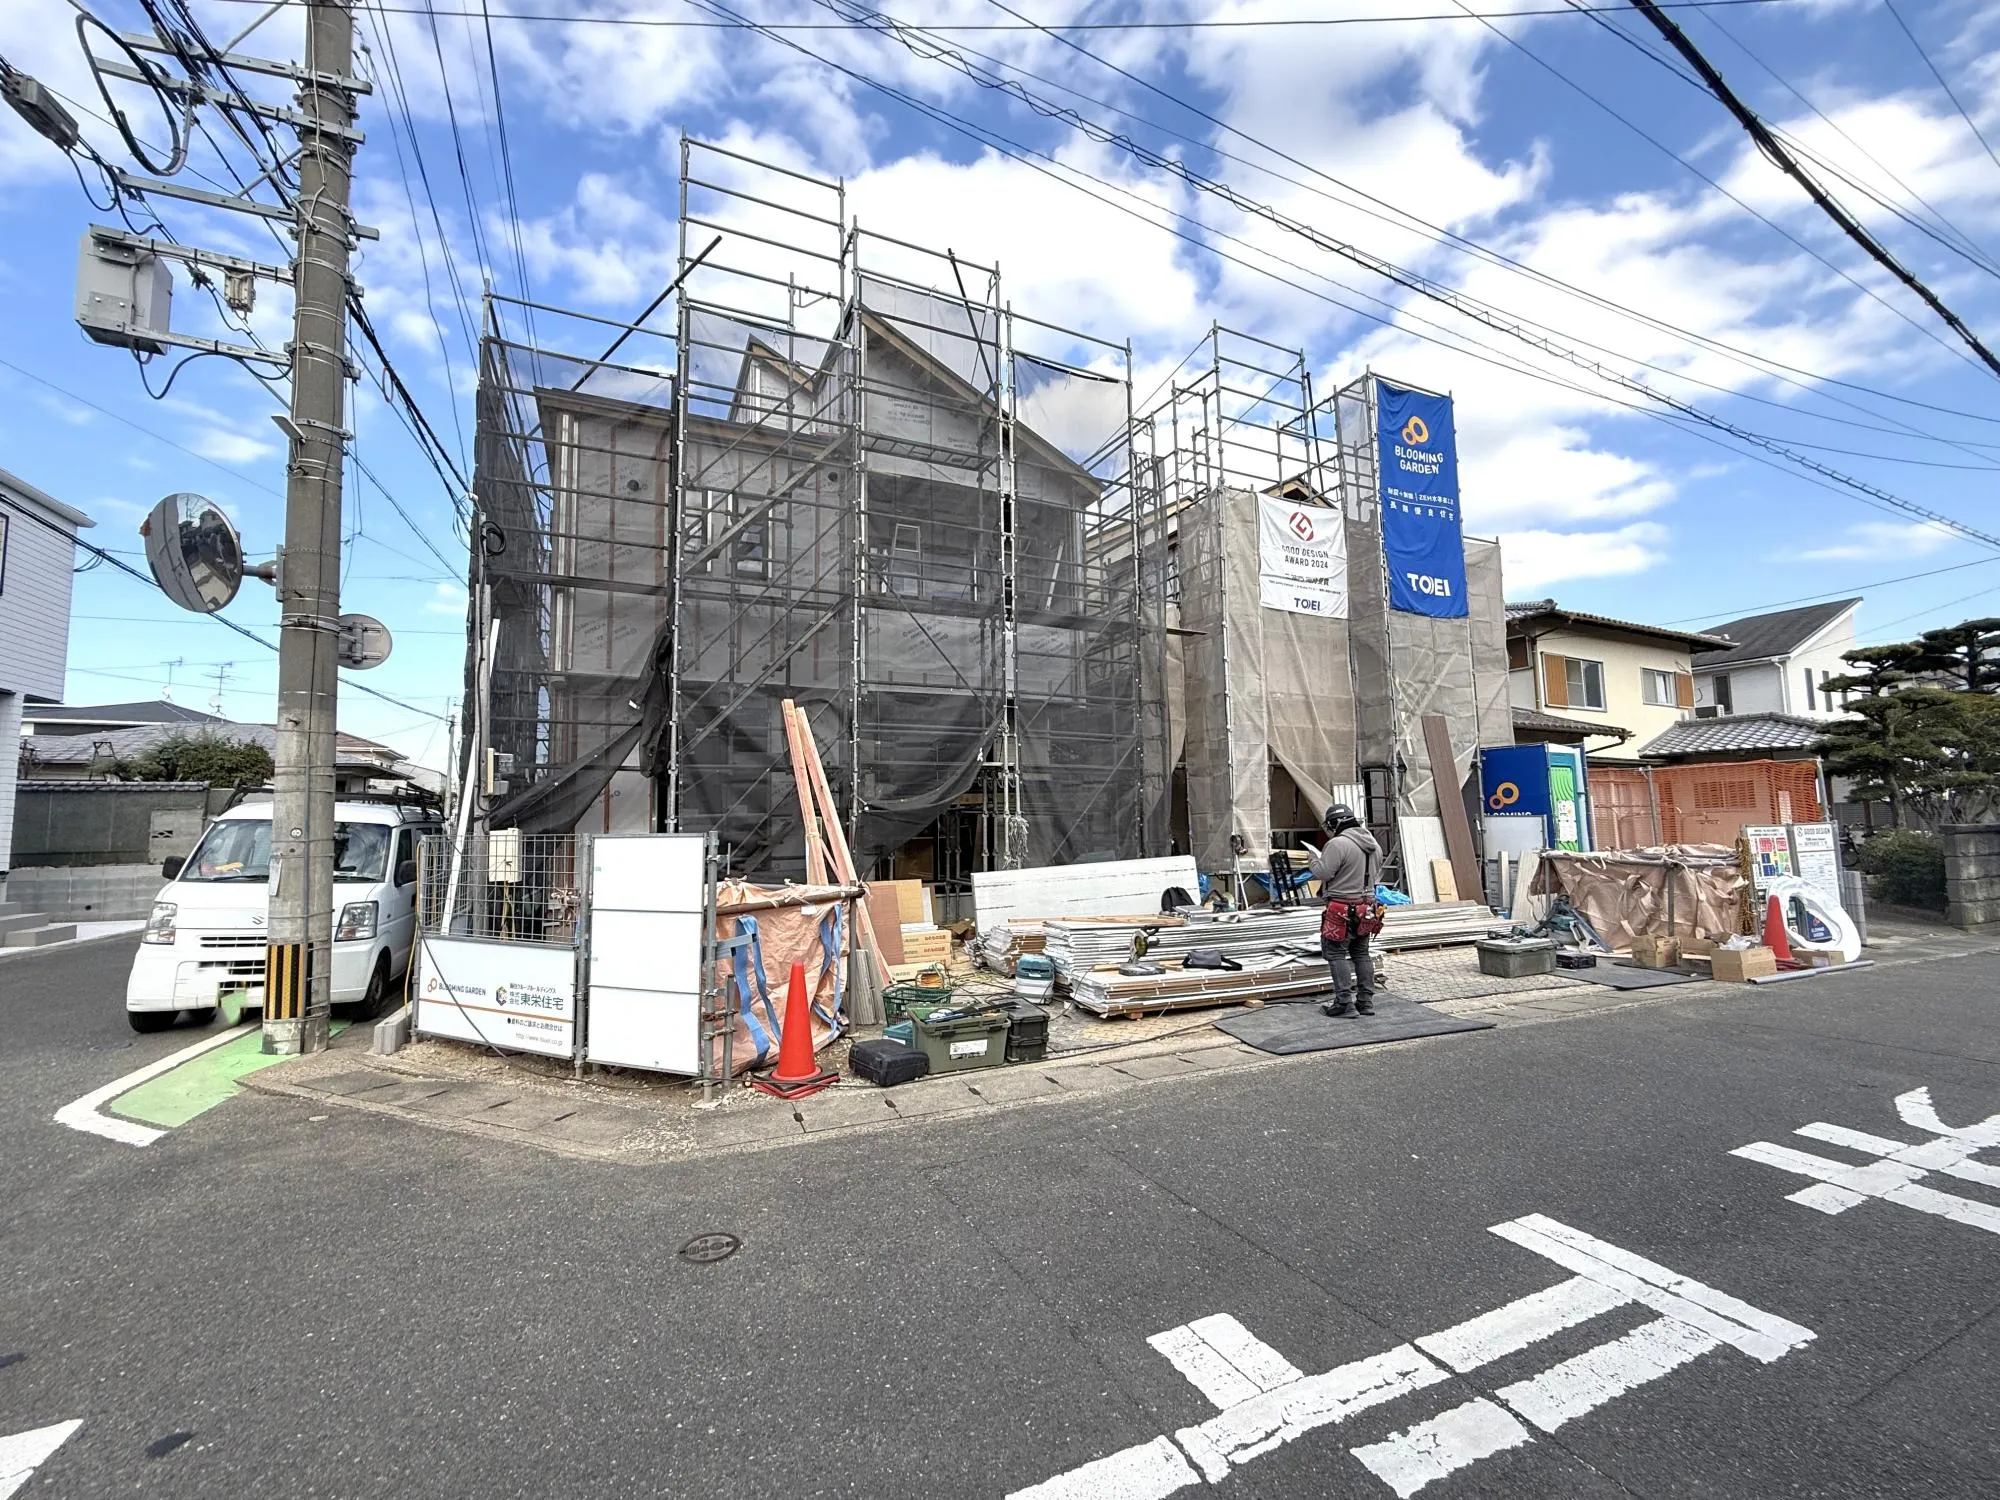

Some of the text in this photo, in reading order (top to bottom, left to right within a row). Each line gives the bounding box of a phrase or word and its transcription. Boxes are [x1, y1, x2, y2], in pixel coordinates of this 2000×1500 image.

[1394, 445, 1444, 463] BLOOMING
[1399, 459, 1439, 475] GARDEN
[1301, 548, 1329, 558] DESIGN
[1284, 555, 1329, 569] AWARD 2024
[1407, 572, 1451, 597] TOEI
[1293, 597, 1321, 611] TOEI
[465, 985, 486, 996] GARDEN
[520, 993, 564, 1011] 東栄住宅
